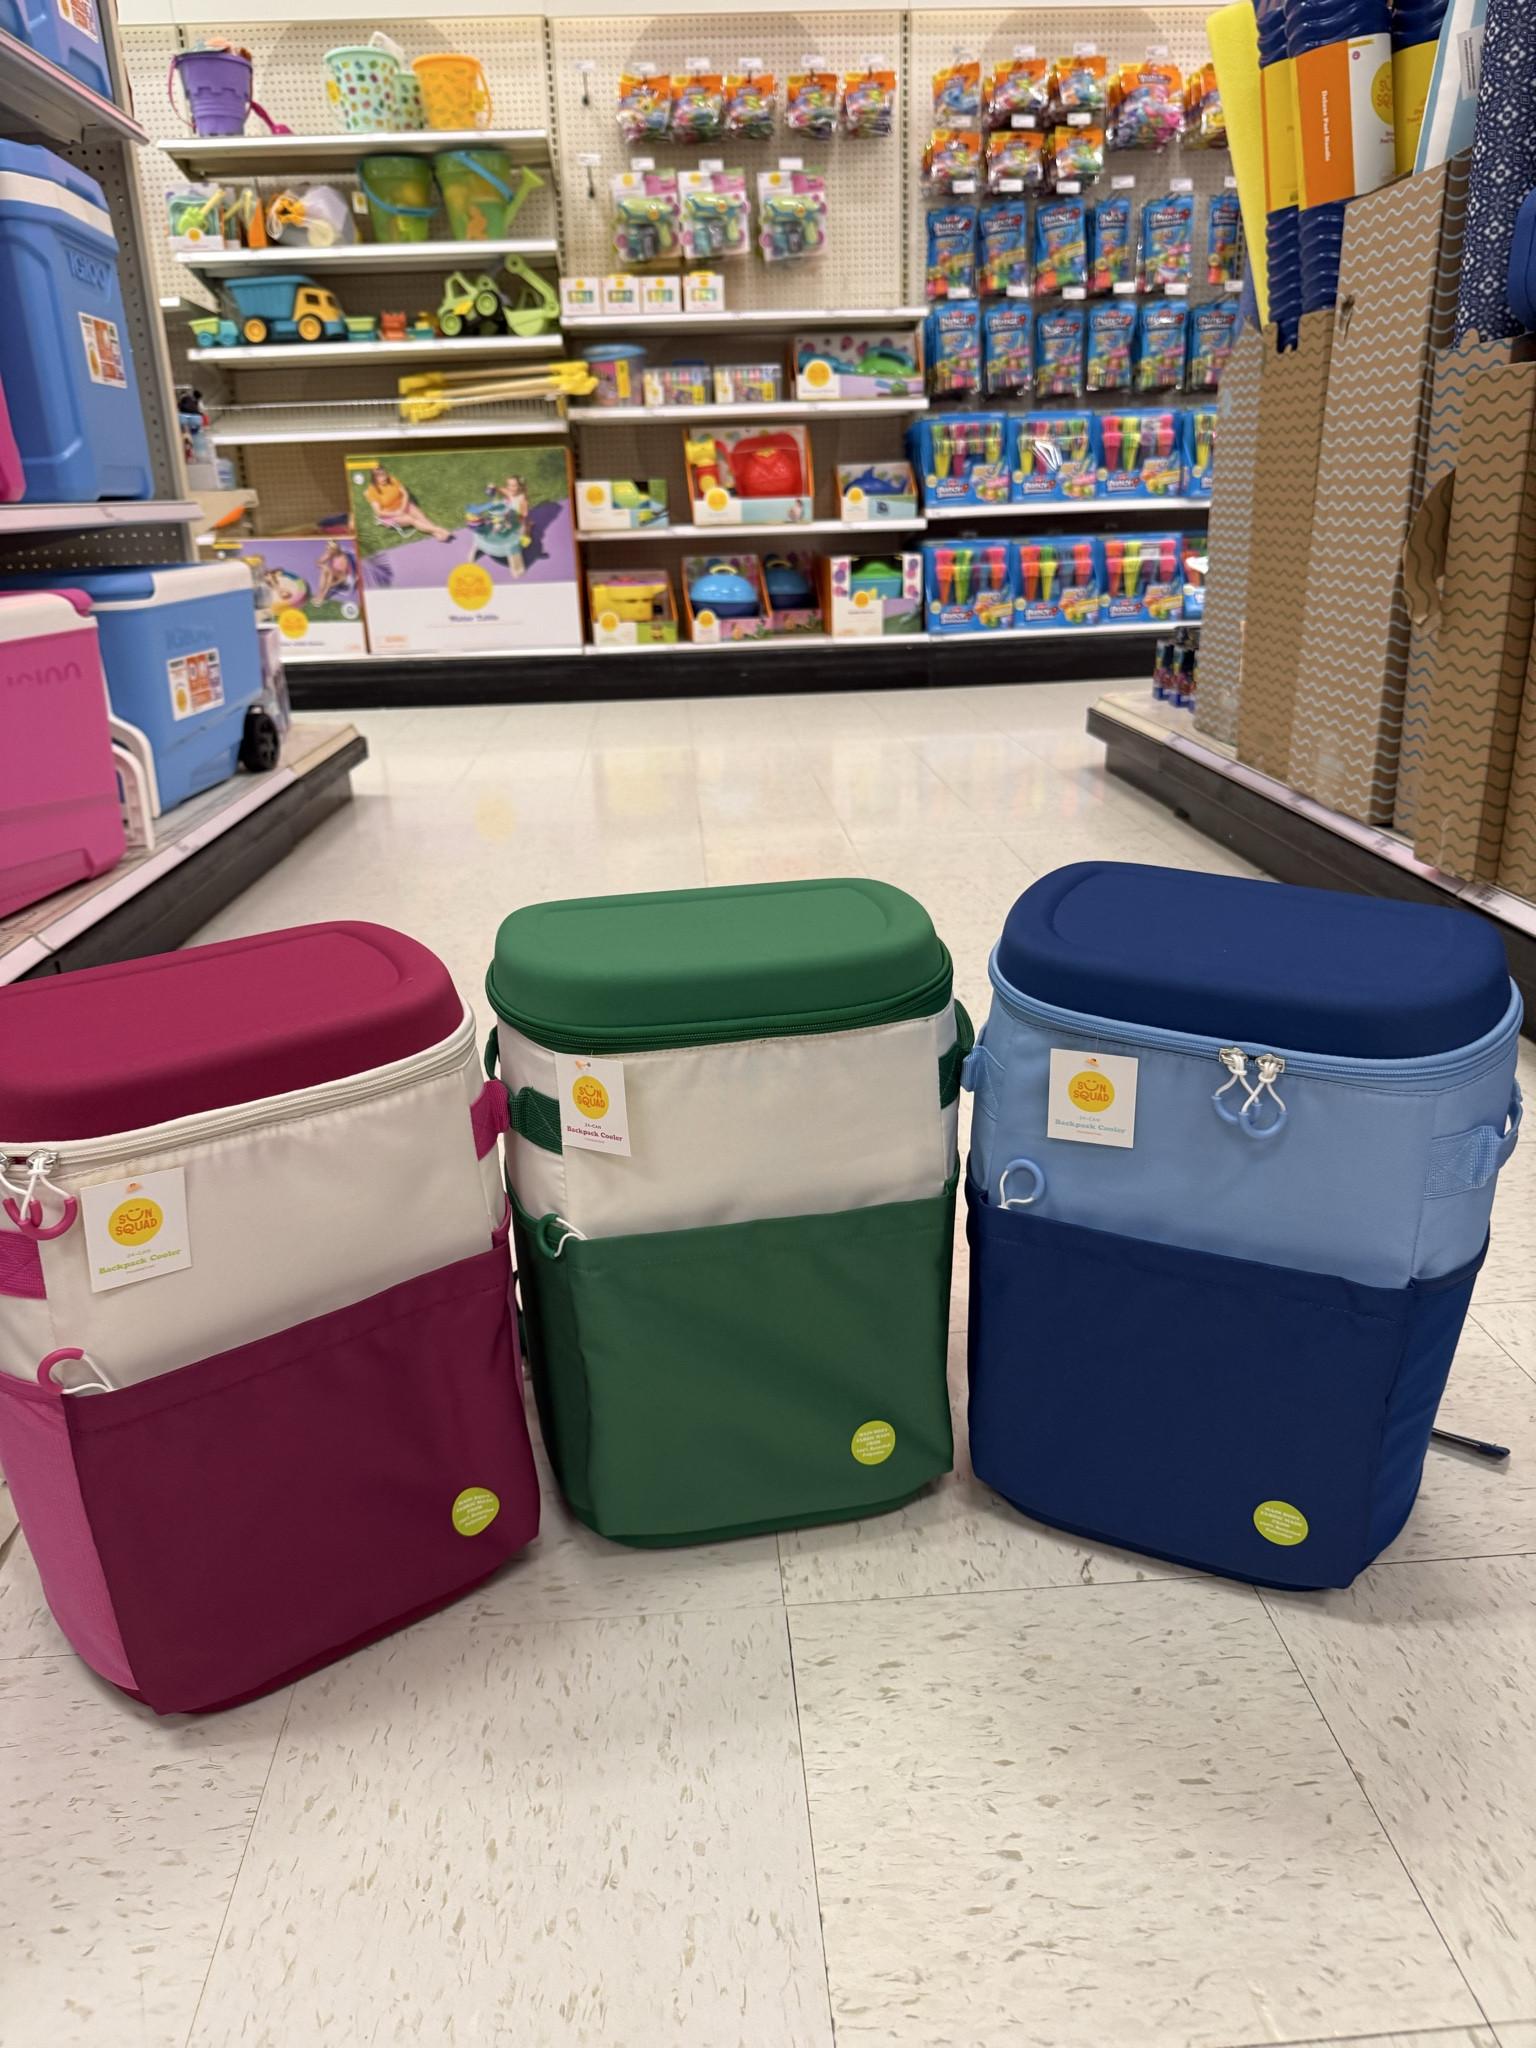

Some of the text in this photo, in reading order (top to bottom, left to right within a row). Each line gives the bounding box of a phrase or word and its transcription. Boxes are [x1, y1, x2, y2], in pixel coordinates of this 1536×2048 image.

[579, 1085, 602, 1097] SUN
[1078, 1080, 1106, 1092] SUN
[577, 1096, 605, 1108] SQUAD
[1074, 1091, 1109, 1102] SQUAD
[1055, 1119, 1096, 1130] Backpack
[1098, 1125, 1126, 1133] Cooler
[567, 1126, 599, 1137] Backpack
[601, 1132, 623, 1142] Cooler
[119, 1208, 152, 1225] SUN
[115, 1218, 158, 1236] SQUAD
[99, 1257, 147, 1275] Backpack
[150, 1248, 182, 1261] Cooler
